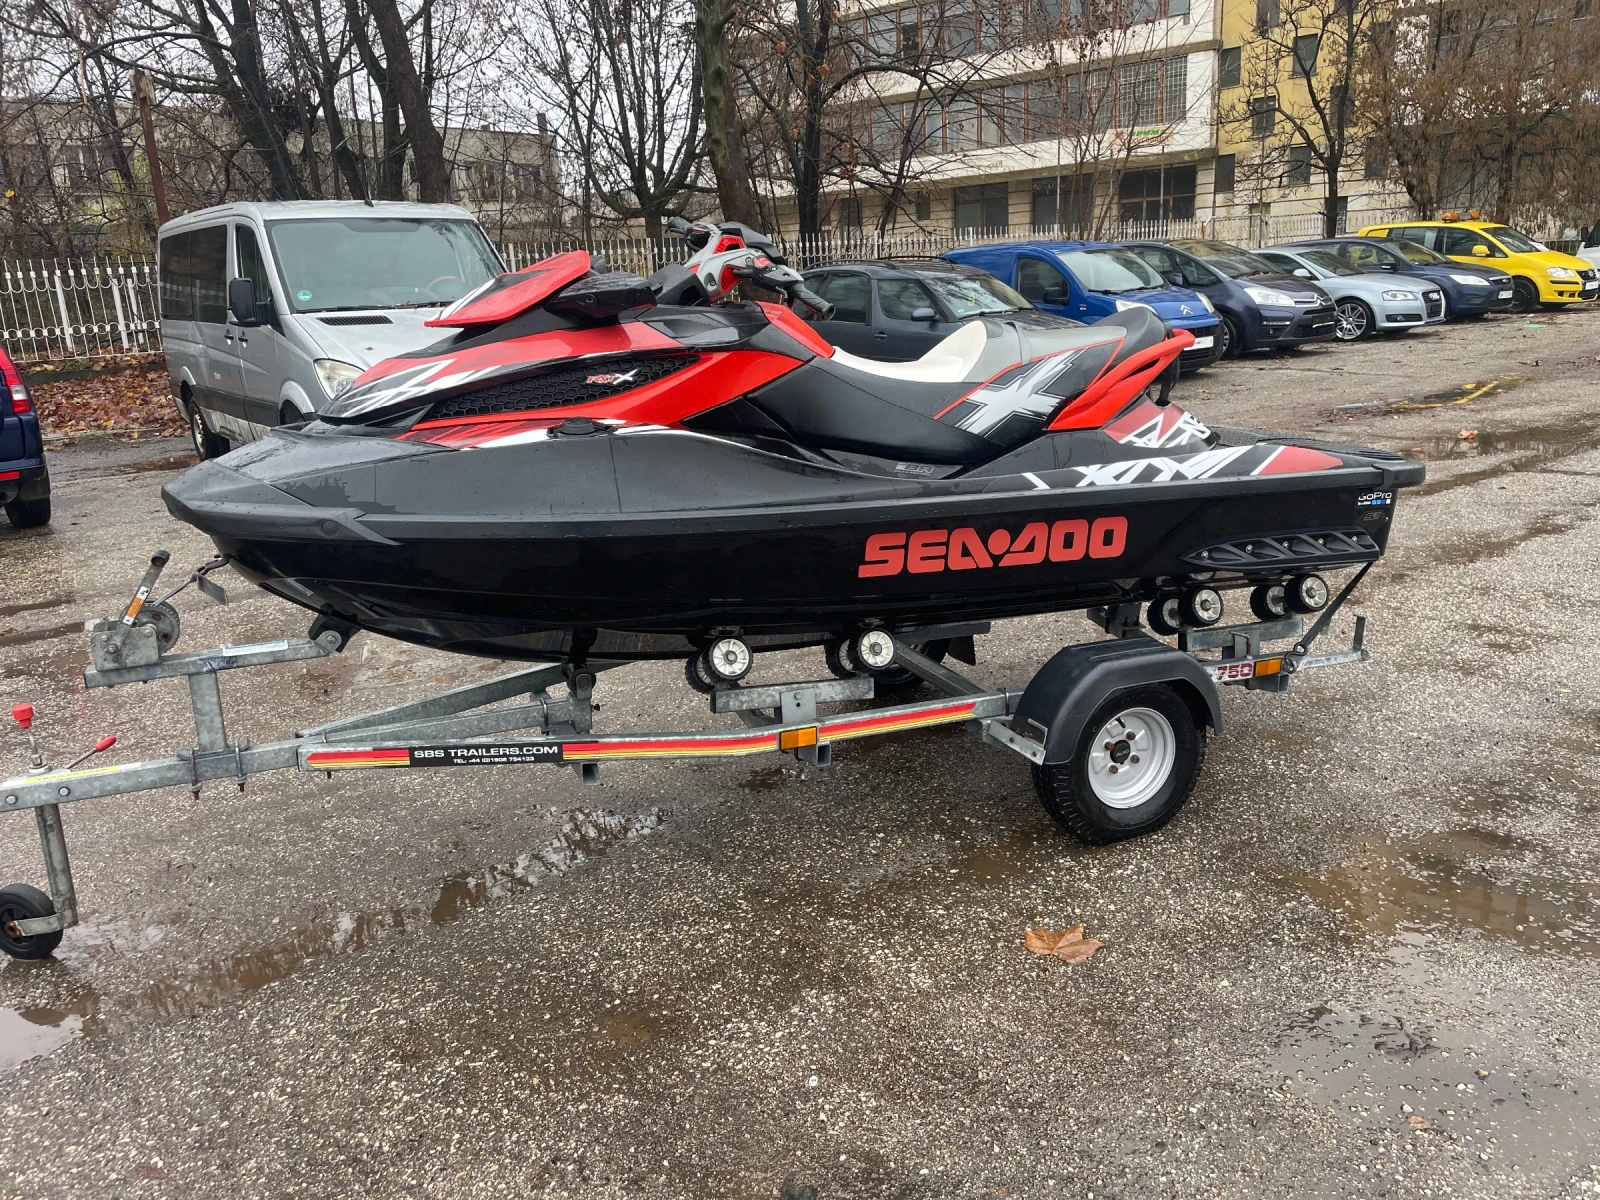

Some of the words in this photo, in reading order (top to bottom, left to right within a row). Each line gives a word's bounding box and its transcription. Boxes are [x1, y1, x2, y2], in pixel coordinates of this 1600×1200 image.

[1358, 491, 1392, 501] GoPro
[1217, 663, 1253, 681] 750
[414, 749, 445, 758] SBS
[447, 746, 558, 757] TRAILERS.COM
